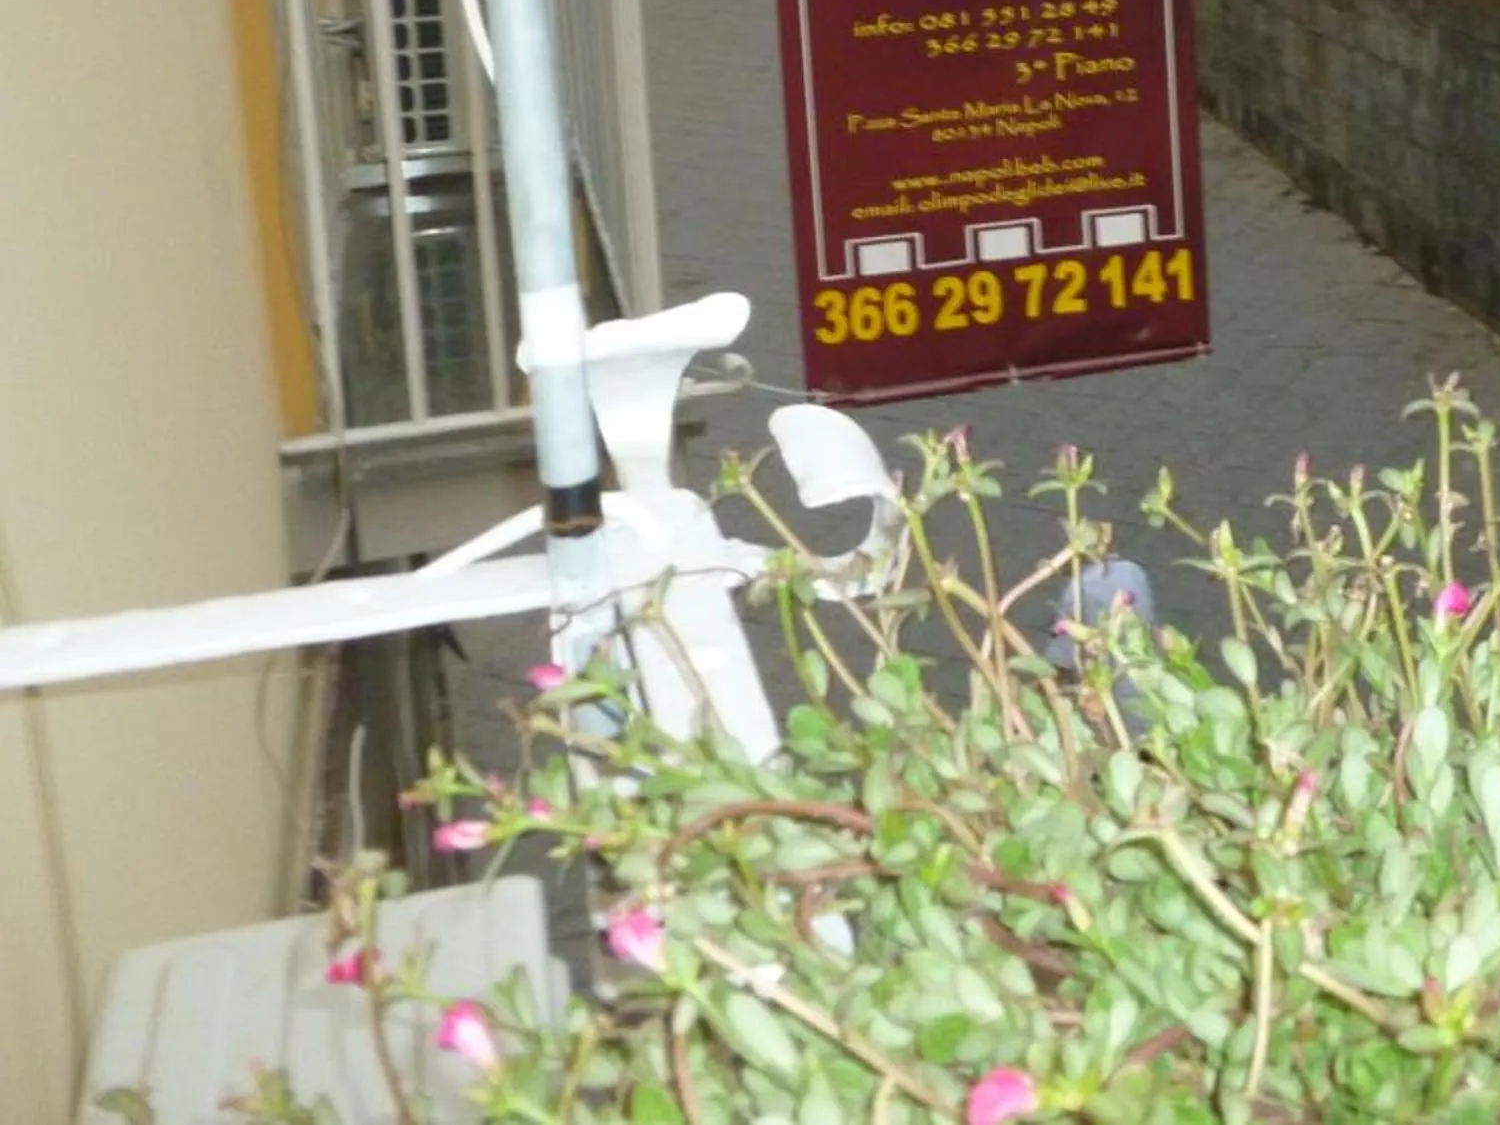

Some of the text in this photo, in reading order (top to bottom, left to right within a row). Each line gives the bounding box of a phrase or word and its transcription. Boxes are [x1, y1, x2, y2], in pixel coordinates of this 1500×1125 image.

[926, 33, 978, 58] 366
[985, 31, 1021, 50] 29
[1027, 27, 1063, 49] 72
[1054, 51, 1136, 81] Piano
[995, 114, 1063, 139] Napoli
[813, 248, 1194, 345] 366 29 72 141
